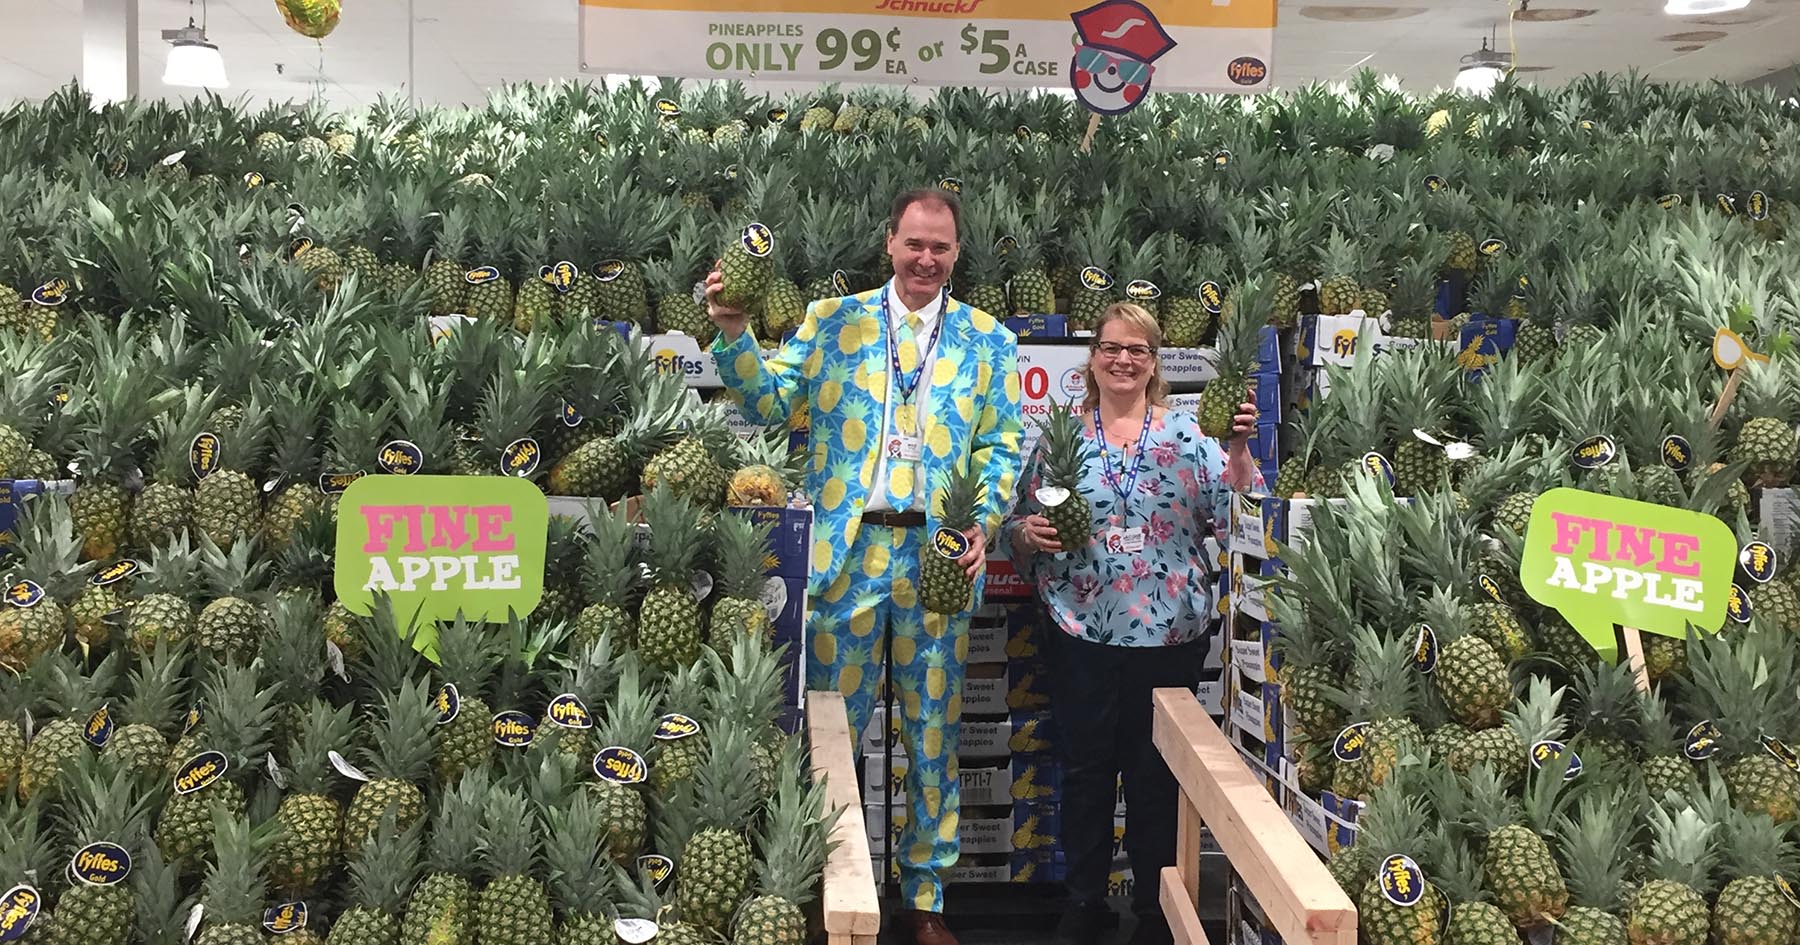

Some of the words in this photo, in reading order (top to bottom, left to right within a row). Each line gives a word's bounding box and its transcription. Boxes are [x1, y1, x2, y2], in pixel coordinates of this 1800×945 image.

[708, 23, 804, 38] PINEAPPLES
[705, 41, 804, 73] ONLY
[918, 40, 944, 62] or
[960, 23, 1010, 74] $5
[1015, 44, 1028, 58] A
[885, 60, 908, 75] EA
[1013, 60, 1058, 77] CASE
[1160, 364, 1203, 373] neapples
[383, 449, 413, 466] fyffes
[360, 504, 516, 553] FINE
[937, 531, 961, 551] fyffes
[1551, 512, 1700, 577] FINE
[362, 554, 521, 591] APPLE
[1546, 556, 1703, 612] APPLE
[966, 682, 995, 691] Sweet
[961, 694, 991, 704] apples
[494, 719, 529, 738] fyffes
[969, 726, 998, 735] Sweet
[177, 760, 217, 791] fyffes
[605, 758, 642, 781] fyffes
[972, 823, 1001, 831] Sweet
[959, 835, 997, 845] eapples
[78, 850, 119, 876] fyffes
[968, 870, 997, 879] Sweet
[1389, 859, 1411, 896] fyffes
